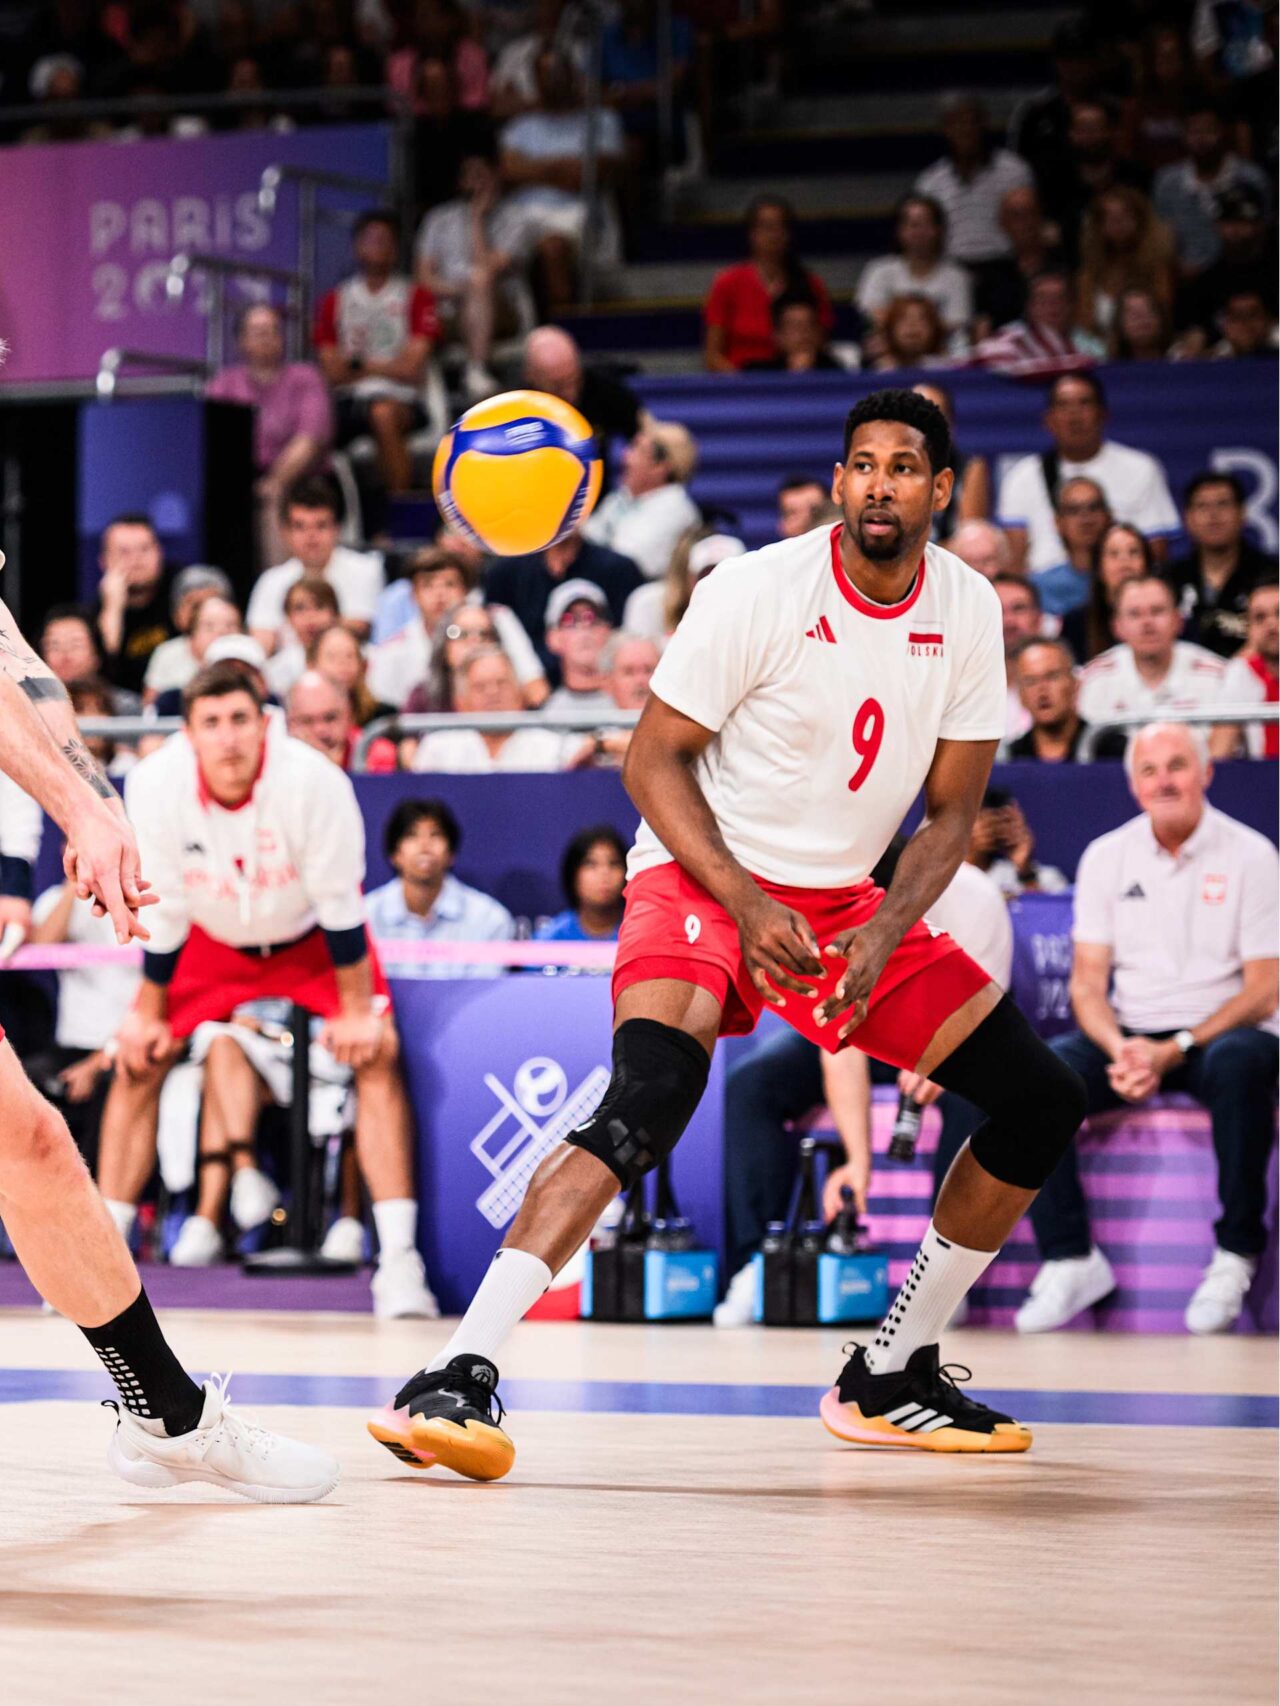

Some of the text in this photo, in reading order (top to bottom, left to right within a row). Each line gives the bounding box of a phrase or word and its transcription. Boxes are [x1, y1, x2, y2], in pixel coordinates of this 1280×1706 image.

[90, 193, 270, 254] PARIS
[847, 697, 885, 792] 9
[684, 913, 702, 945] 9
